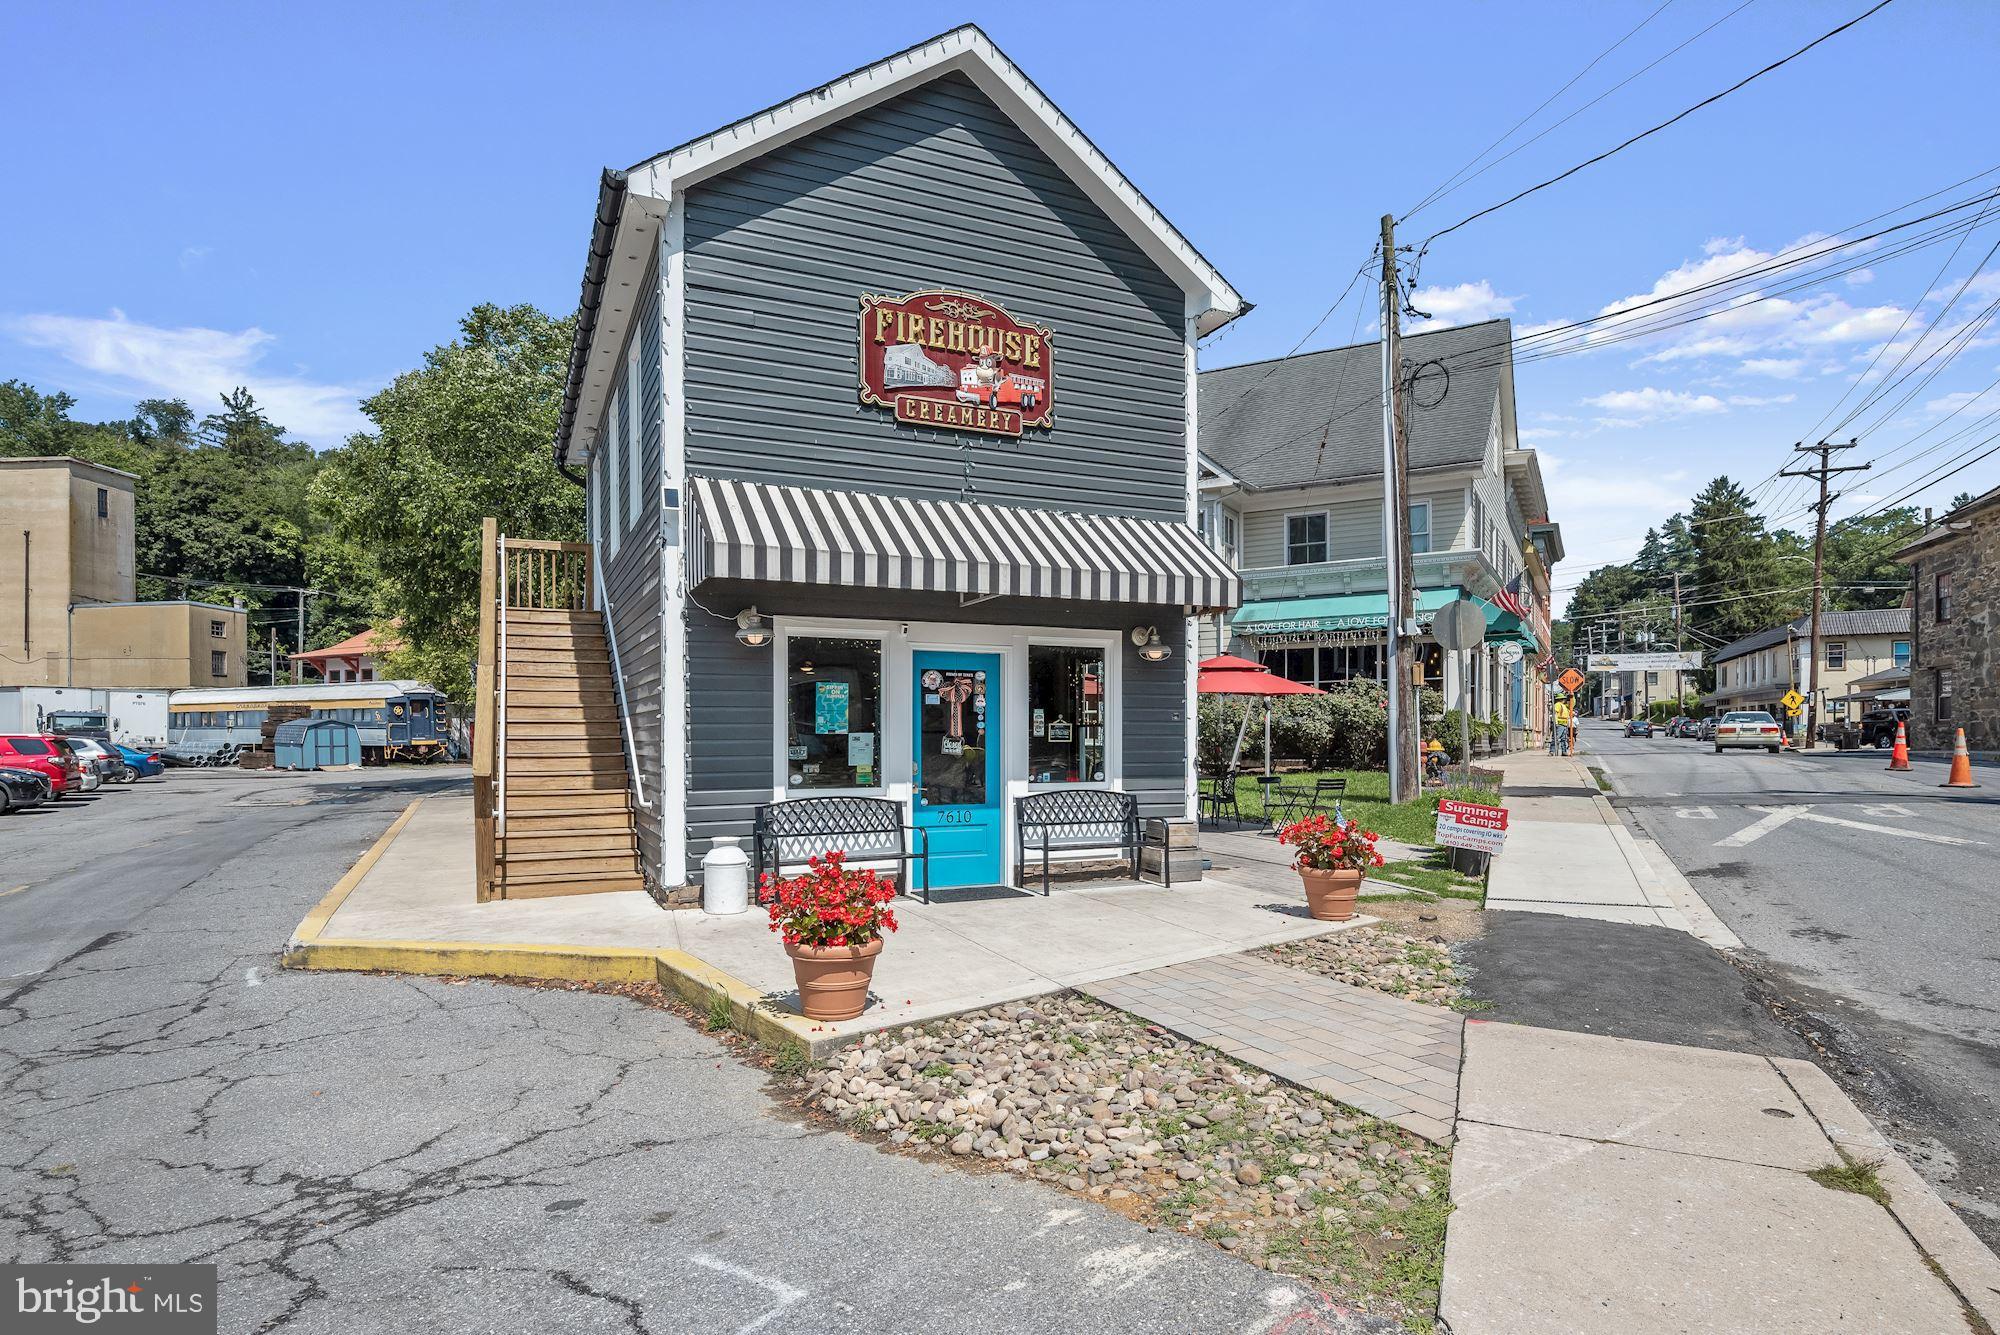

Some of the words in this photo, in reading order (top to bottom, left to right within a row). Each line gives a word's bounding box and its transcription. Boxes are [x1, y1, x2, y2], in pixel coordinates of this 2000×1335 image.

[875, 308, 1041, 368] FIREHOUSE
[905, 400, 1012, 431] CREAMERY
[1246, 624, 1252, 632] A
[1255, 623, 1276, 631] LOVE
[1278, 622, 1295, 630] FOR
[1299, 620, 1319, 629] HAIR
[1338, 618, 1344, 626] A
[1348, 617, 1370, 626] LOVE
[937, 810, 972, 824] 7610
[1445, 801, 1504, 819] Summer
[1462, 815, 1502, 829] Camps
[1437, 831, 1503, 847] TopFunCamps.com
[1463, 828, 1485, 838] covering
